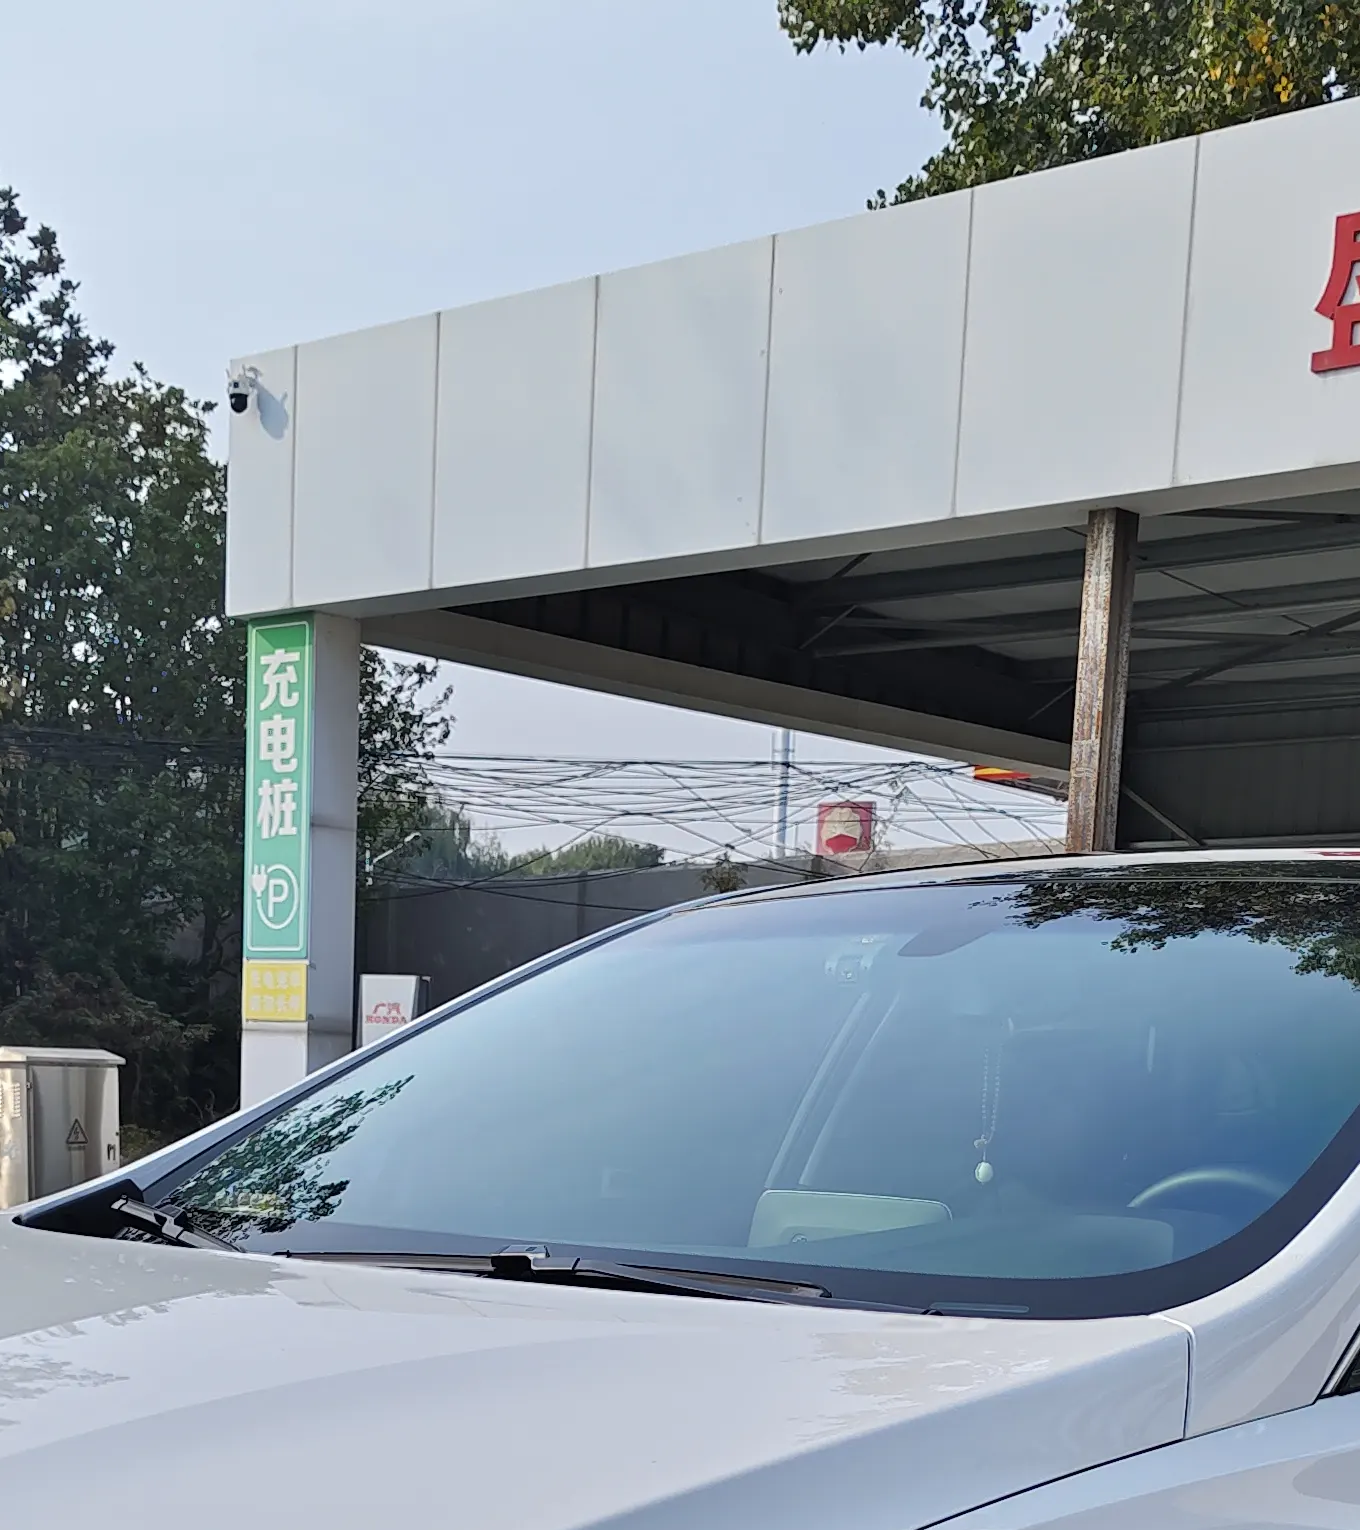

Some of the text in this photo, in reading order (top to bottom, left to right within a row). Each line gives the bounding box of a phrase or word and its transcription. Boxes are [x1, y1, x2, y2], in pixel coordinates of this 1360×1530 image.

[257, 648, 301, 839] 充电桩
[268, 878, 290, 919] P
